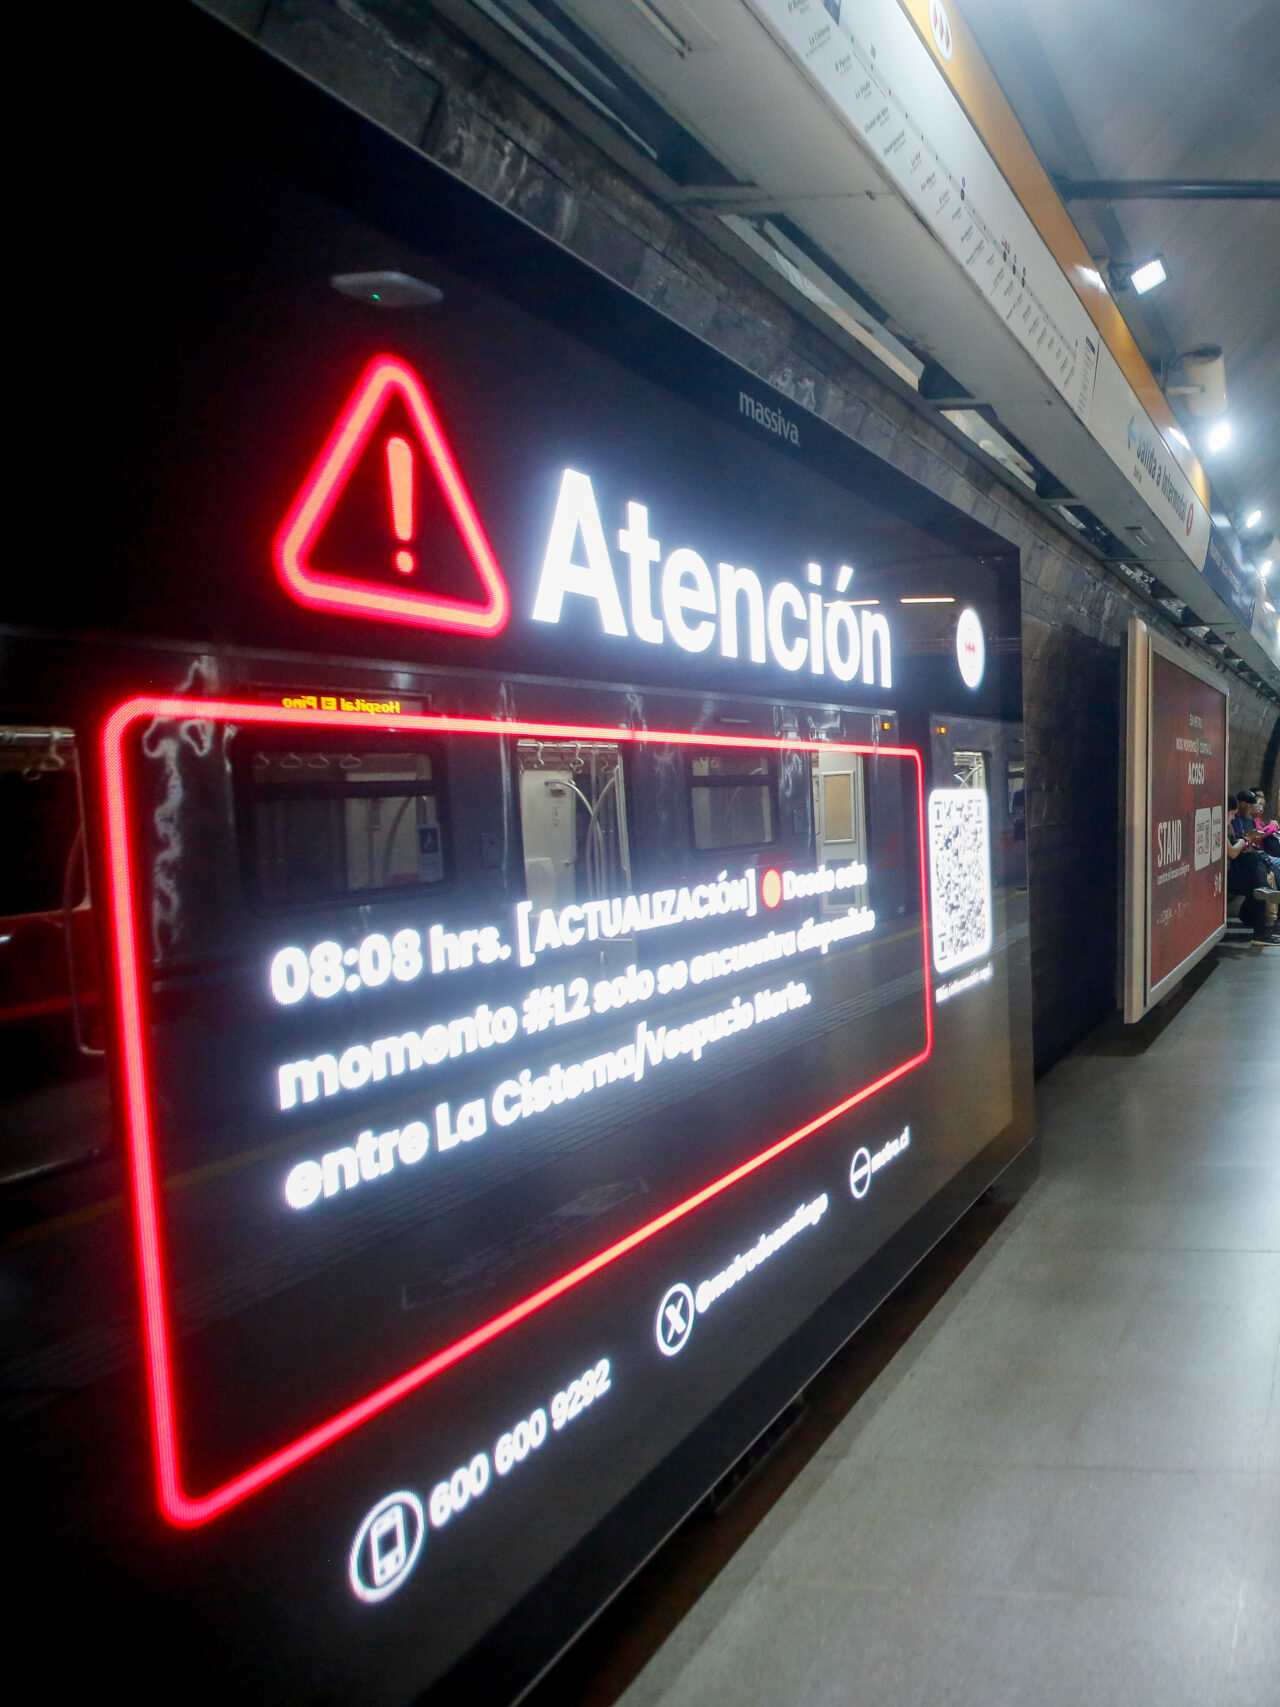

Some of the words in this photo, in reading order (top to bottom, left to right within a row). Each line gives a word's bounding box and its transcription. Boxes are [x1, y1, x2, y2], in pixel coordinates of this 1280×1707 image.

[739, 391, 800, 447] massiva
[532, 468, 893, 690] Atención
[1187, 761, 1205, 785] ACOSO
[1157, 819, 1182, 868] STAND
[270, 928, 423, 1005] 08:08
[429, 924, 512, 974] hrs.
[516, 868, 757, 968] [ACTUALIZACIÓN]
[278, 1004, 519, 1110] momento
[521, 977, 591, 1035] #L2
[592, 964, 655, 1014] solo
[656, 960, 689, 995] se
[285, 1121, 430, 1210] entre
[435, 1098, 488, 1152] La
[429, 1454, 489, 1526] 600
[494, 1409, 547, 1474] 600
[551, 1359, 611, 1430] 9292
